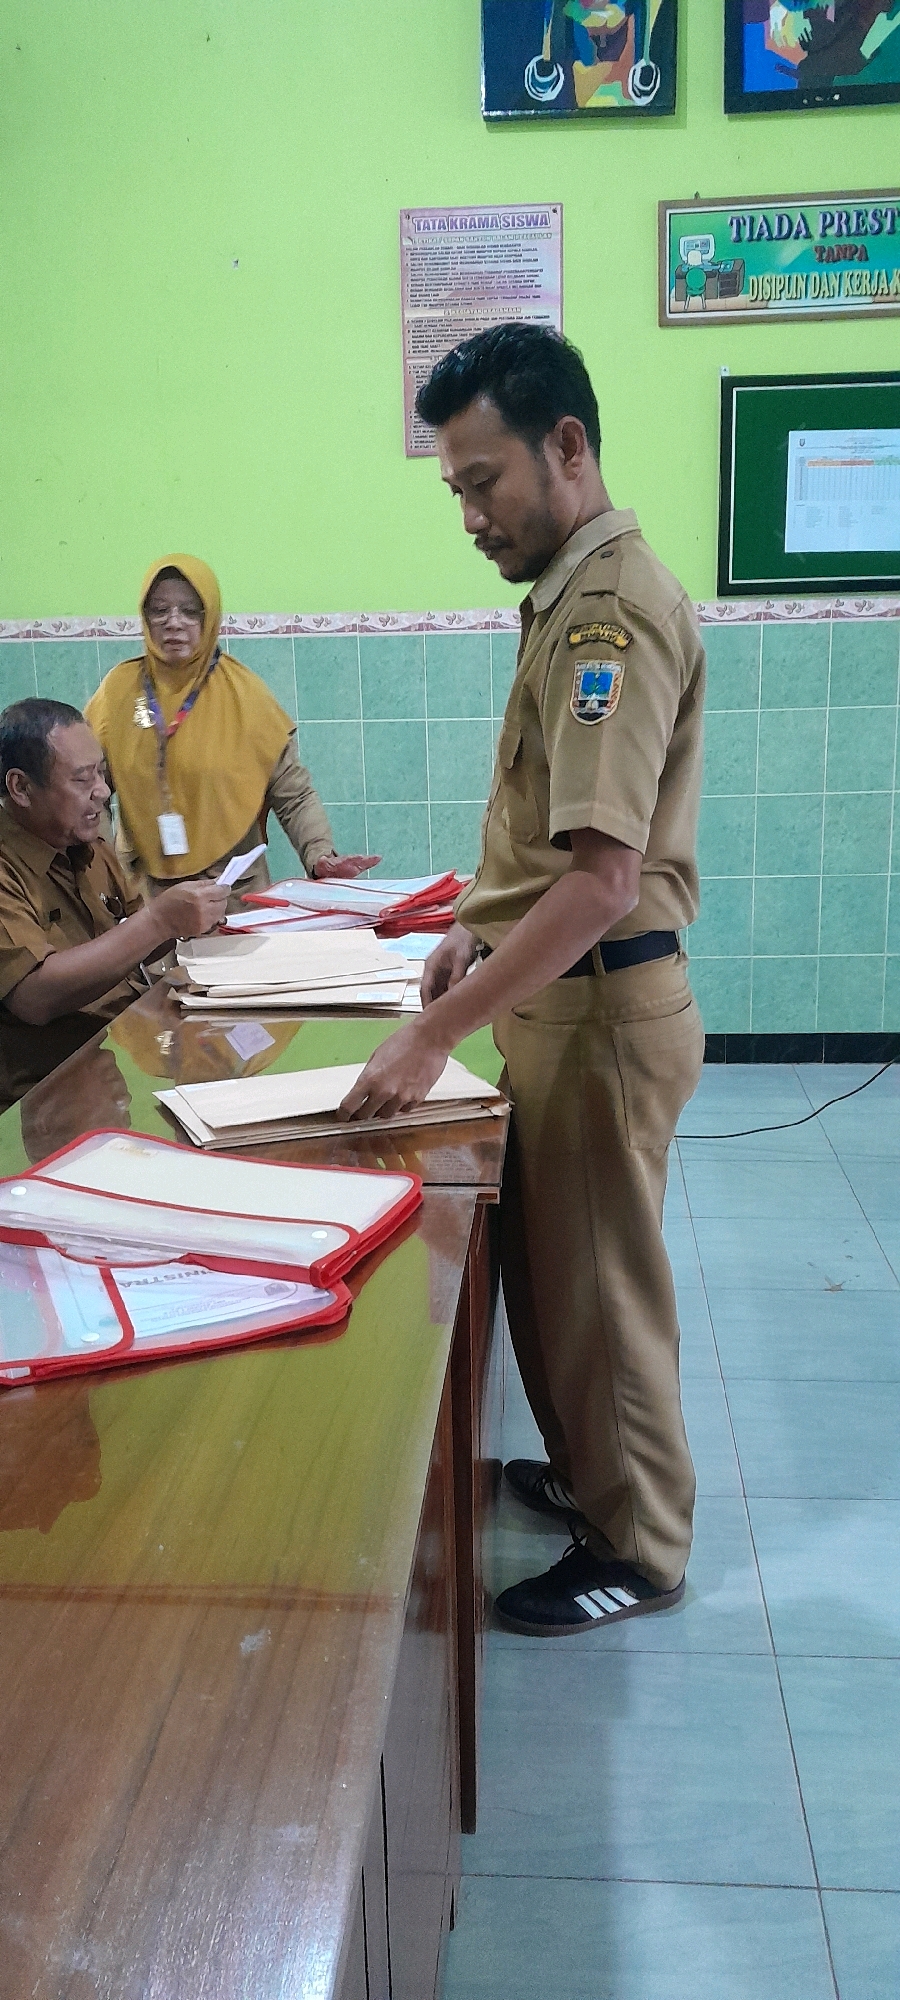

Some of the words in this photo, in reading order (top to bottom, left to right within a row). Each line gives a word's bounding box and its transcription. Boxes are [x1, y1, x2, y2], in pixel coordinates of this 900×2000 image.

[413, 217, 448, 232] TATA
[449, 214, 500, 231] KRAMA
[501, 212, 550, 229] SISWA
[729, 212, 812, 242] TIADA
[818, 207, 900, 237] PREST
[814, 244, 869, 263] TANPA
[750, 273, 807, 301] DISIPLIN
[809, 271, 841, 299] DAN
[842, 269, 890, 297] KERJA
